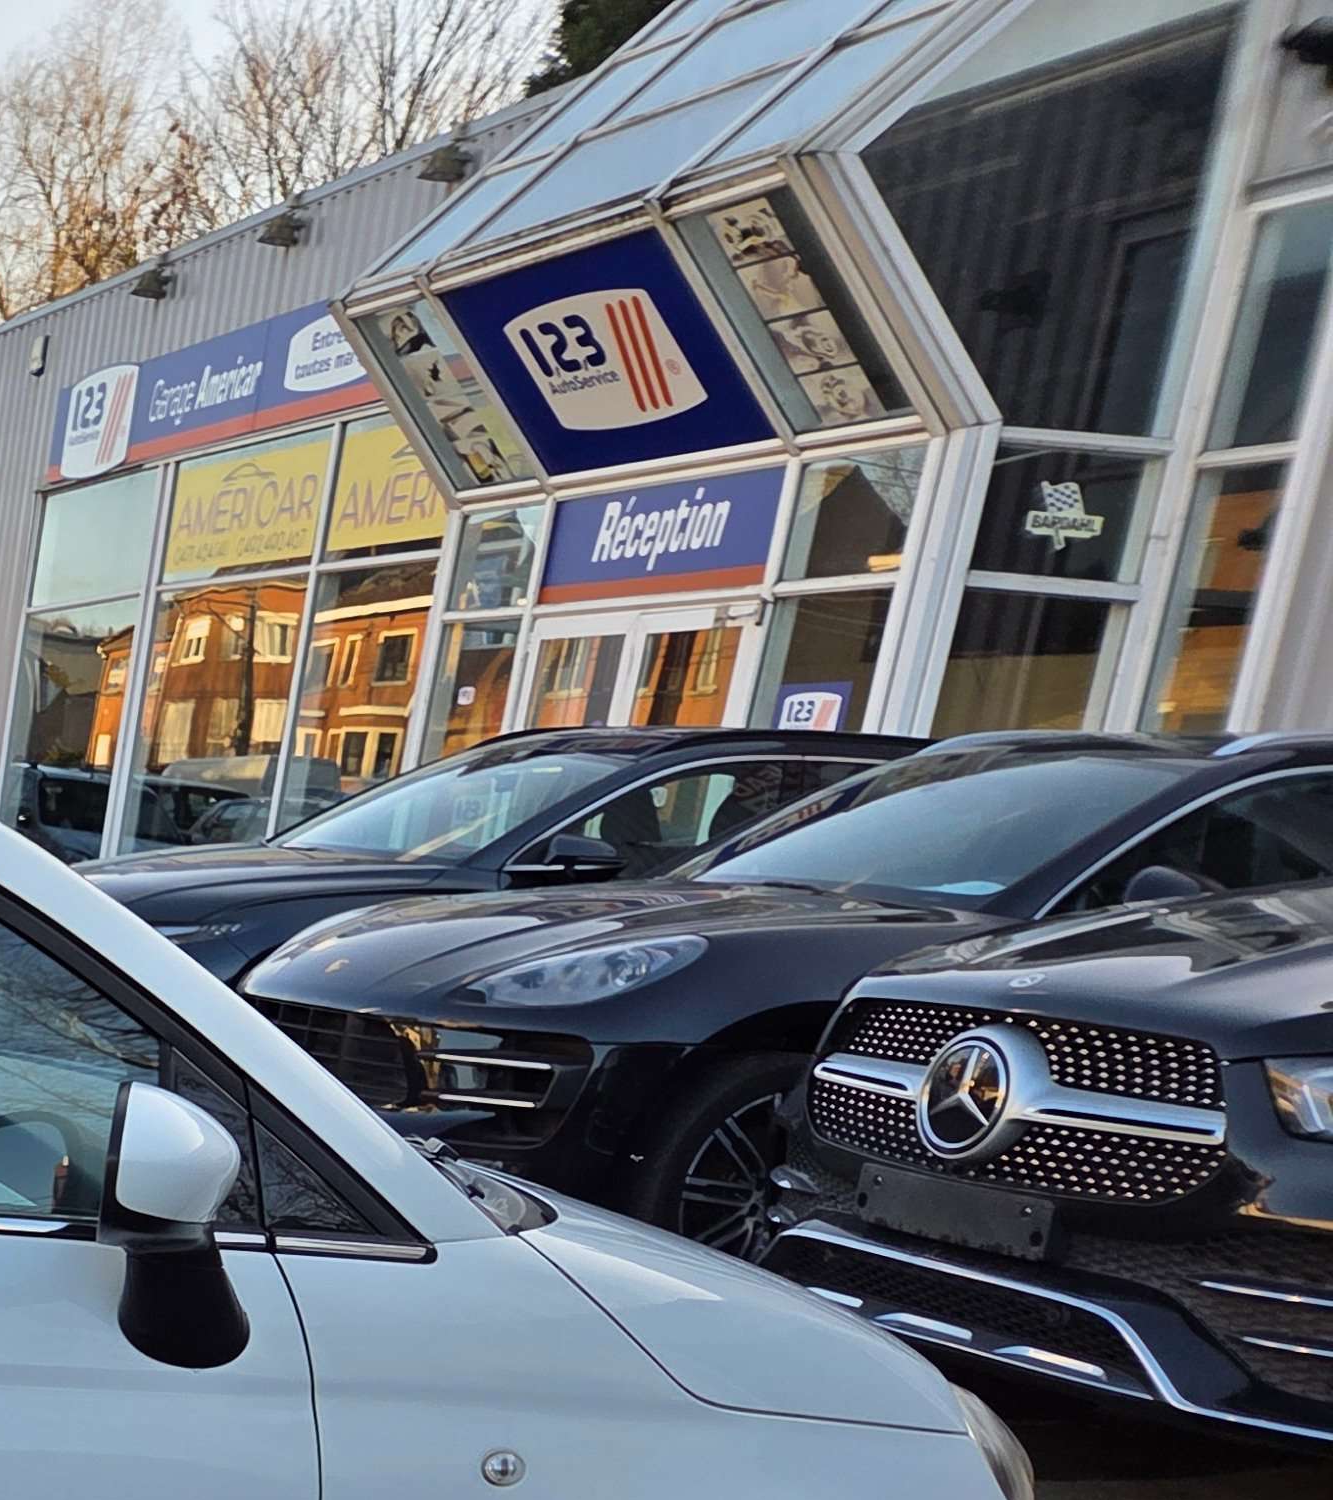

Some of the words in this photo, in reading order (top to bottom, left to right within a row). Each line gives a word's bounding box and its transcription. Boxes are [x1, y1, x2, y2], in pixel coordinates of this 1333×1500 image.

[548, 369, 620, 395] AutoService
[175, 473, 319, 538] AMERICAR
[591, 487, 731, 571] Réception
